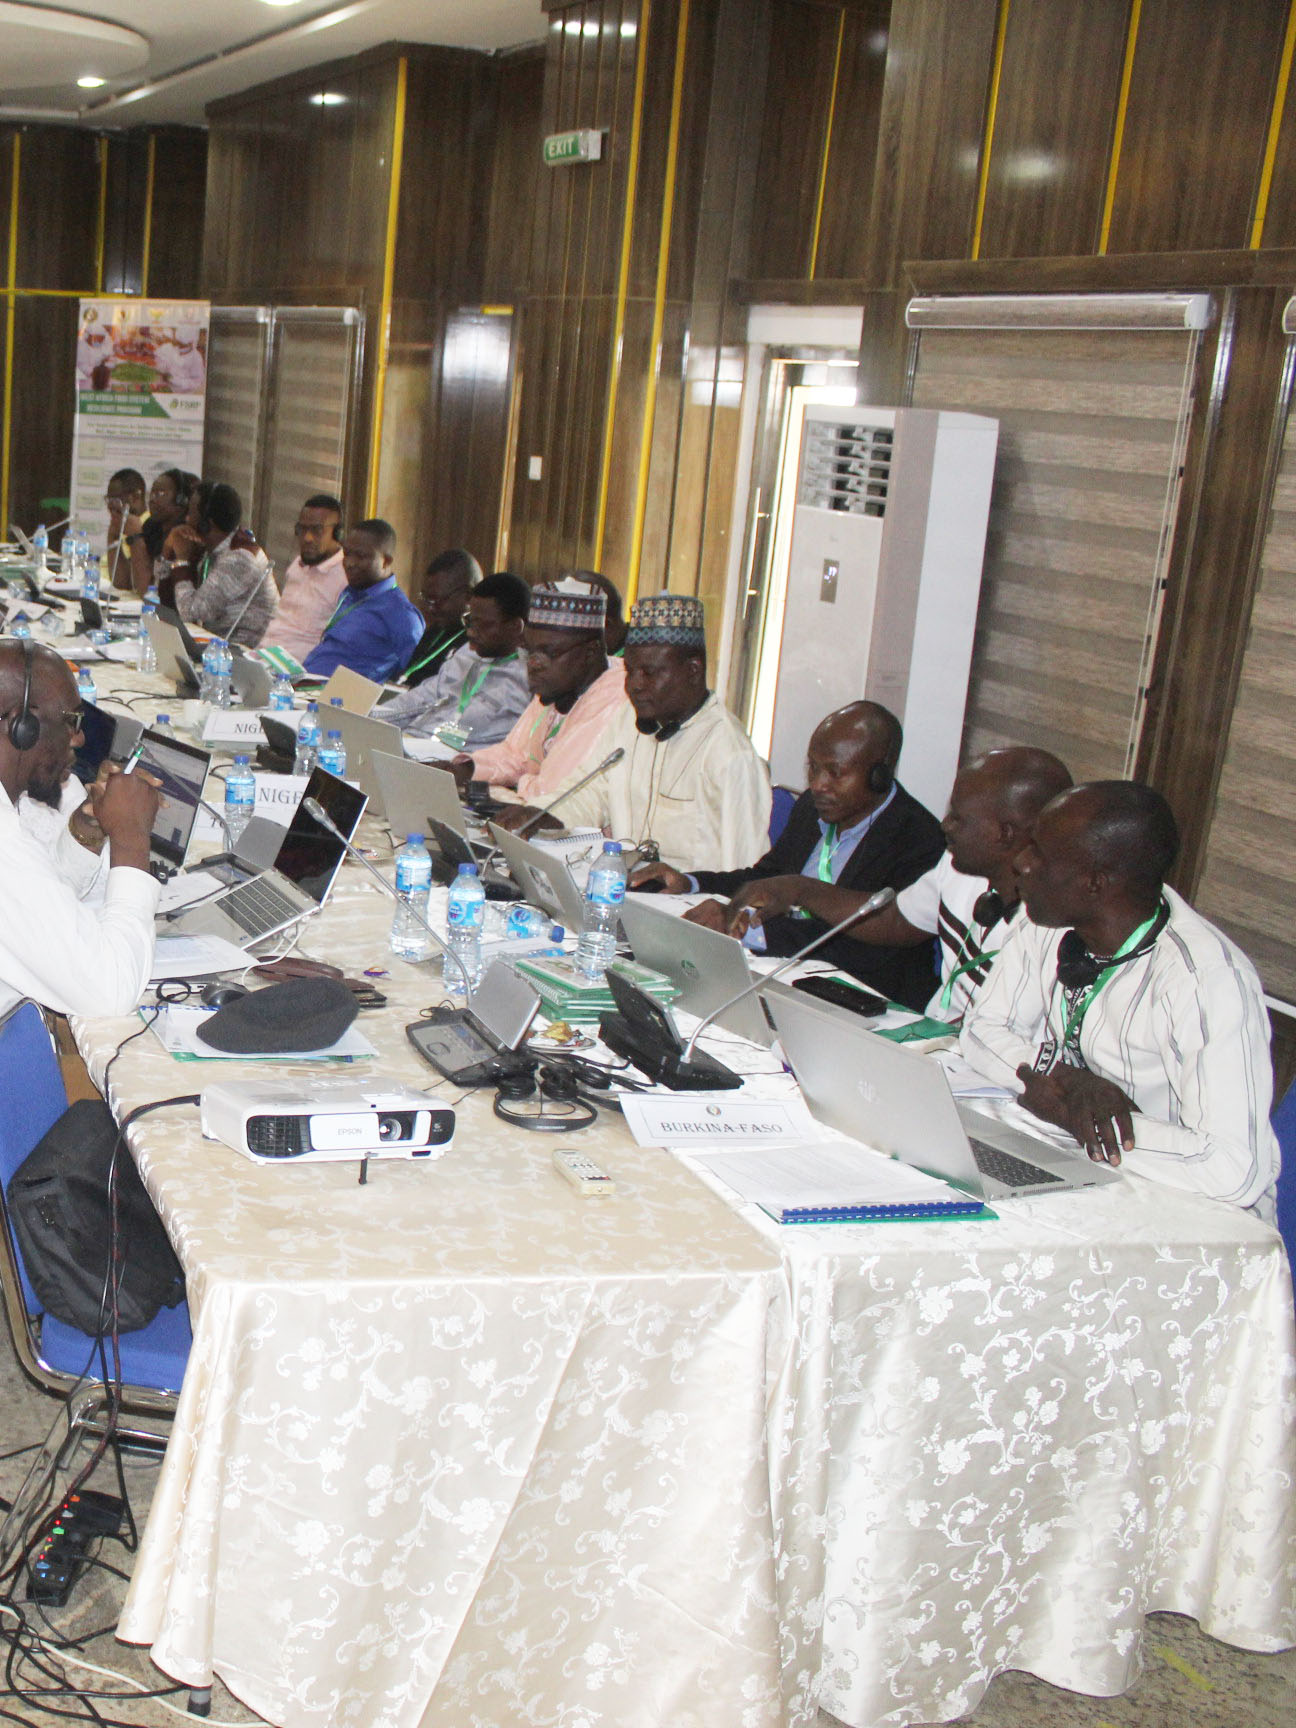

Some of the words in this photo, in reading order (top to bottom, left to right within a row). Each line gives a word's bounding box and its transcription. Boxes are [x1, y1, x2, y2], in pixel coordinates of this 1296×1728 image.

[548, 137, 574, 158] EXIT
[337, 1127, 363, 1136] EPSON
[660, 1121, 783, 1134] BURKINA-FASO
